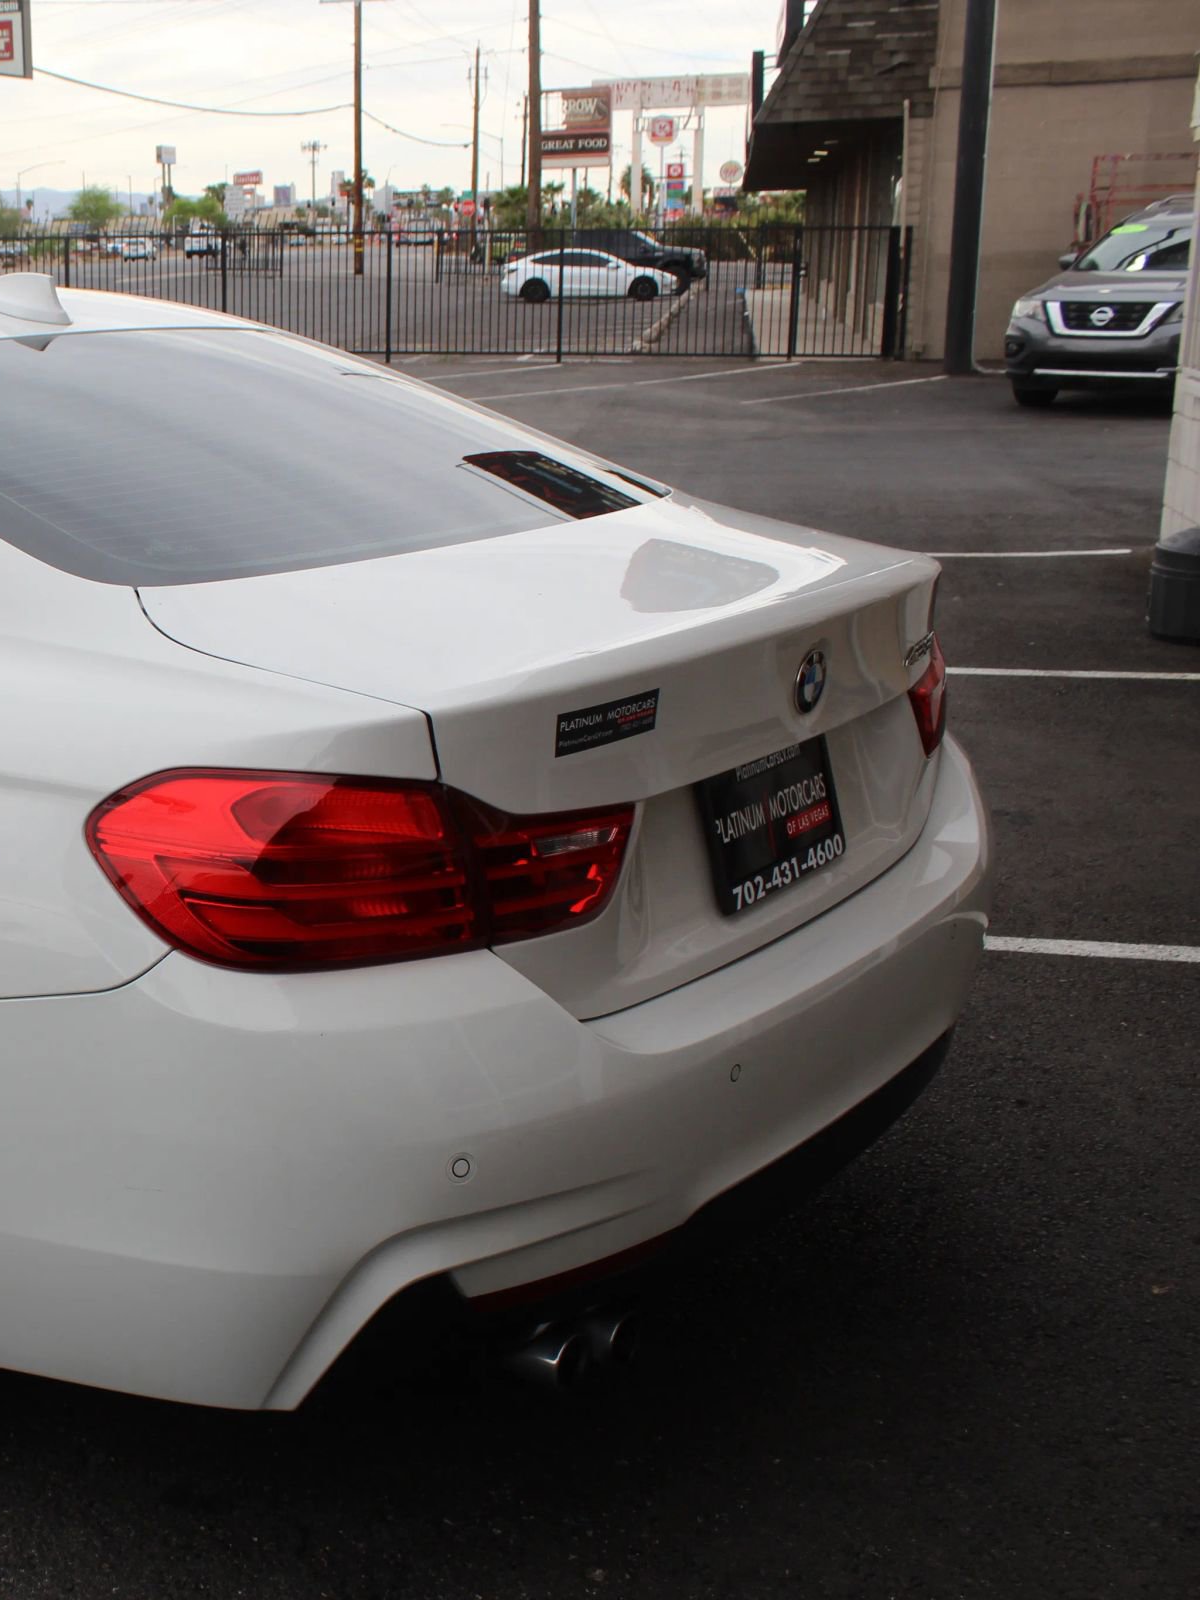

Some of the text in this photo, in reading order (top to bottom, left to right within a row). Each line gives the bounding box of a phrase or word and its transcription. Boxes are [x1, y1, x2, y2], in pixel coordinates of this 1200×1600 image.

[541, 137, 608, 150] GREAT FOOD
[560, 714, 603, 732] PLATINUM
[606, 697, 656, 720] MOTORCARS
[768, 772, 827, 821] MOTORCARS
[786, 804, 830, 835] OF LAS VEGAS
[732, 833, 843, 911] 702-431-4600
